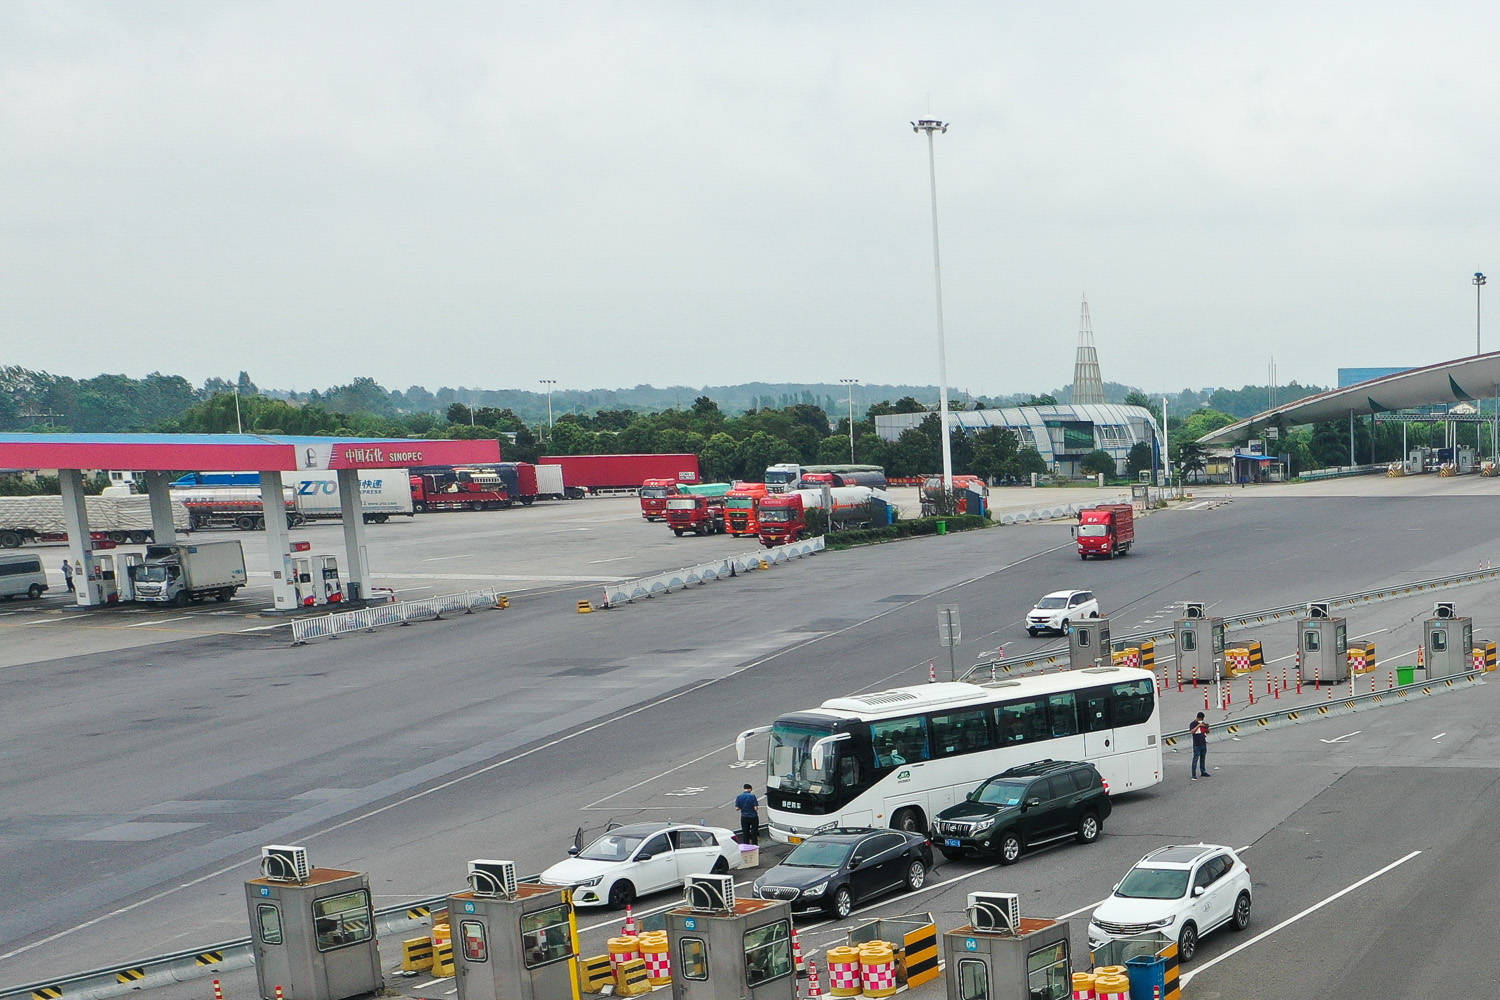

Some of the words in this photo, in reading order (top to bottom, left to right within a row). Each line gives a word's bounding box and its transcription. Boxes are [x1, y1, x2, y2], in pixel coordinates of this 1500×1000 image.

[345, 448, 384, 463] 中国石化
[389, 451, 423, 462] SINOPEC
[298, 480, 337, 496] ZTO
[359, 479, 383, 489] 快递
[966, 940, 976, 948] 04
